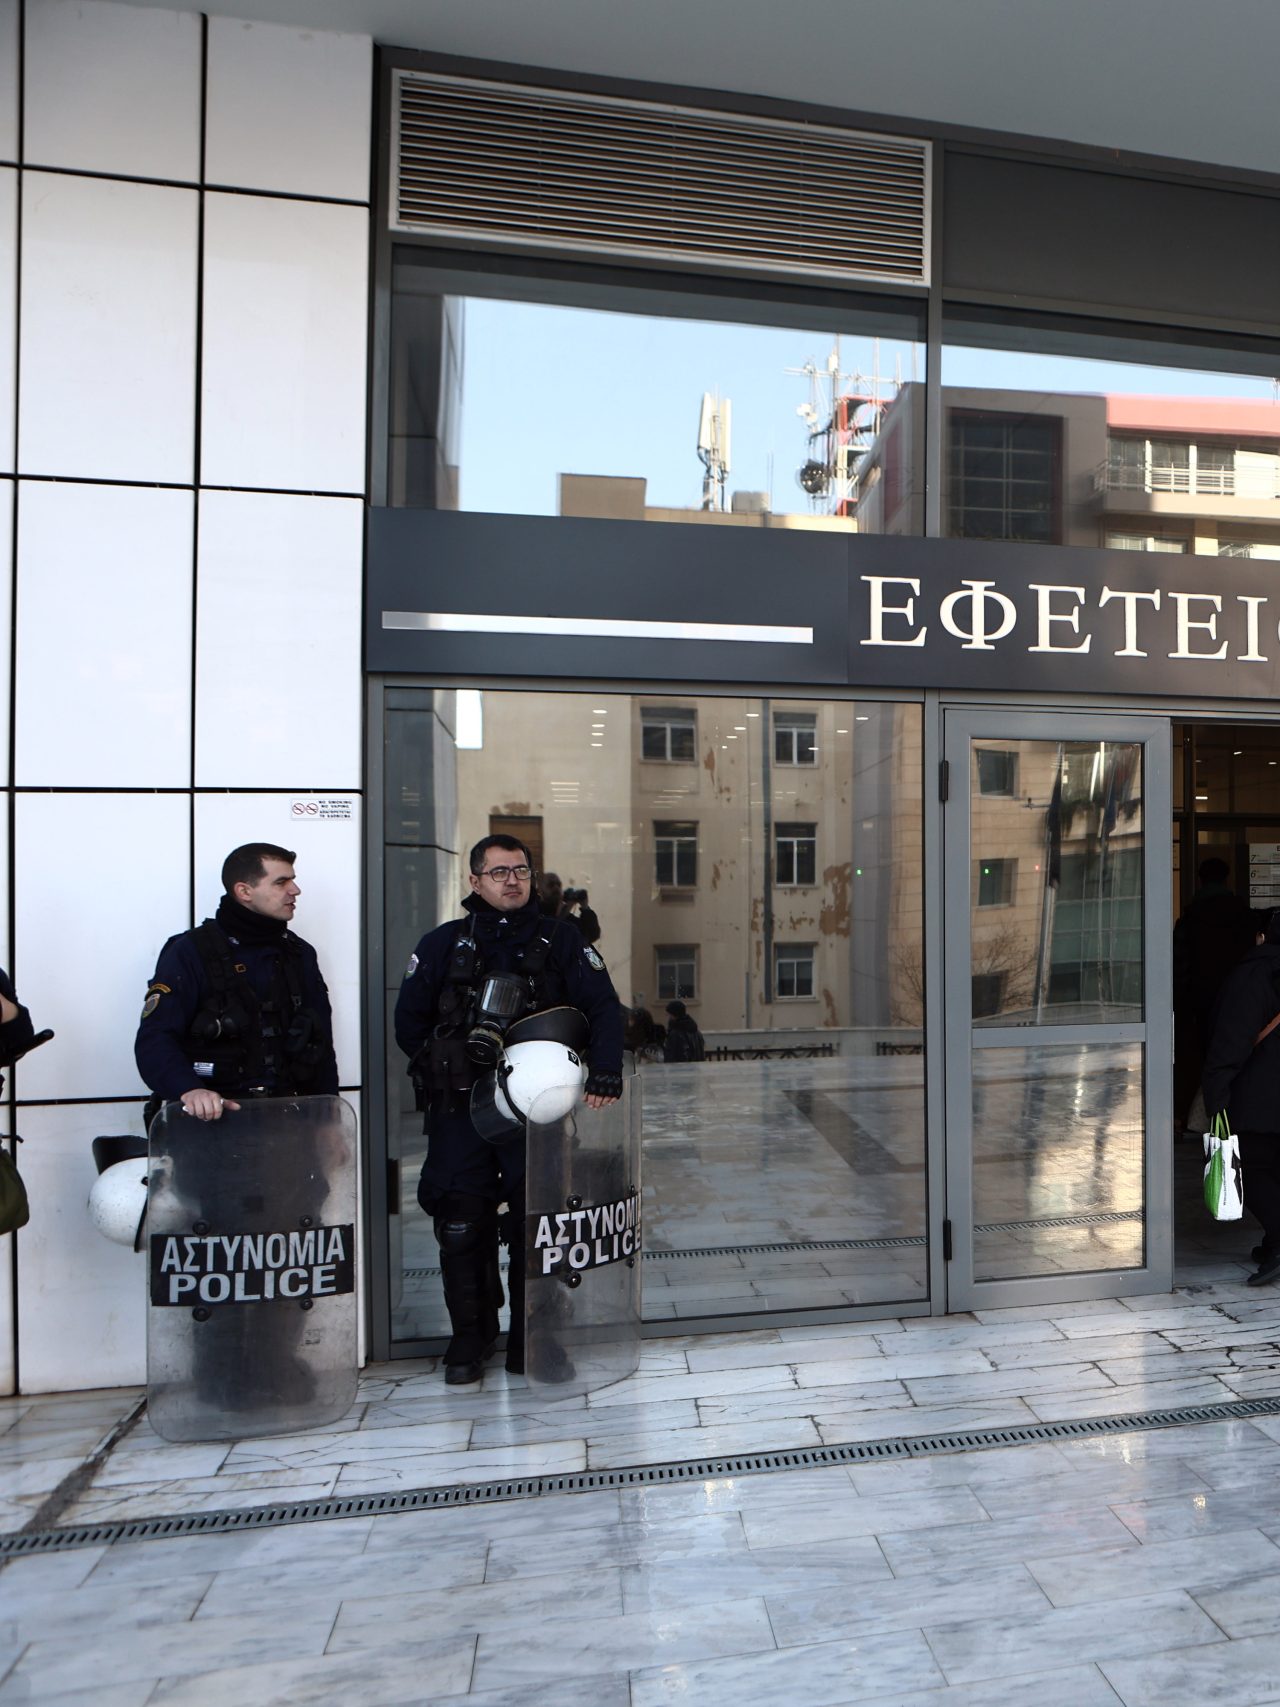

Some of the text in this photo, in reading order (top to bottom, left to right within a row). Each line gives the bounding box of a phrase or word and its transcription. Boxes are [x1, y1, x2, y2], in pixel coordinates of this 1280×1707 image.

[534, 1193, 641, 1249] ΑΣΤΥΝΟΜΙ
[160, 1227, 346, 1273] ΑΣΤΥΝΟΜΙΑ
[542, 1223, 641, 1275] POLICE
[169, 1264, 337, 1304] POLICE
